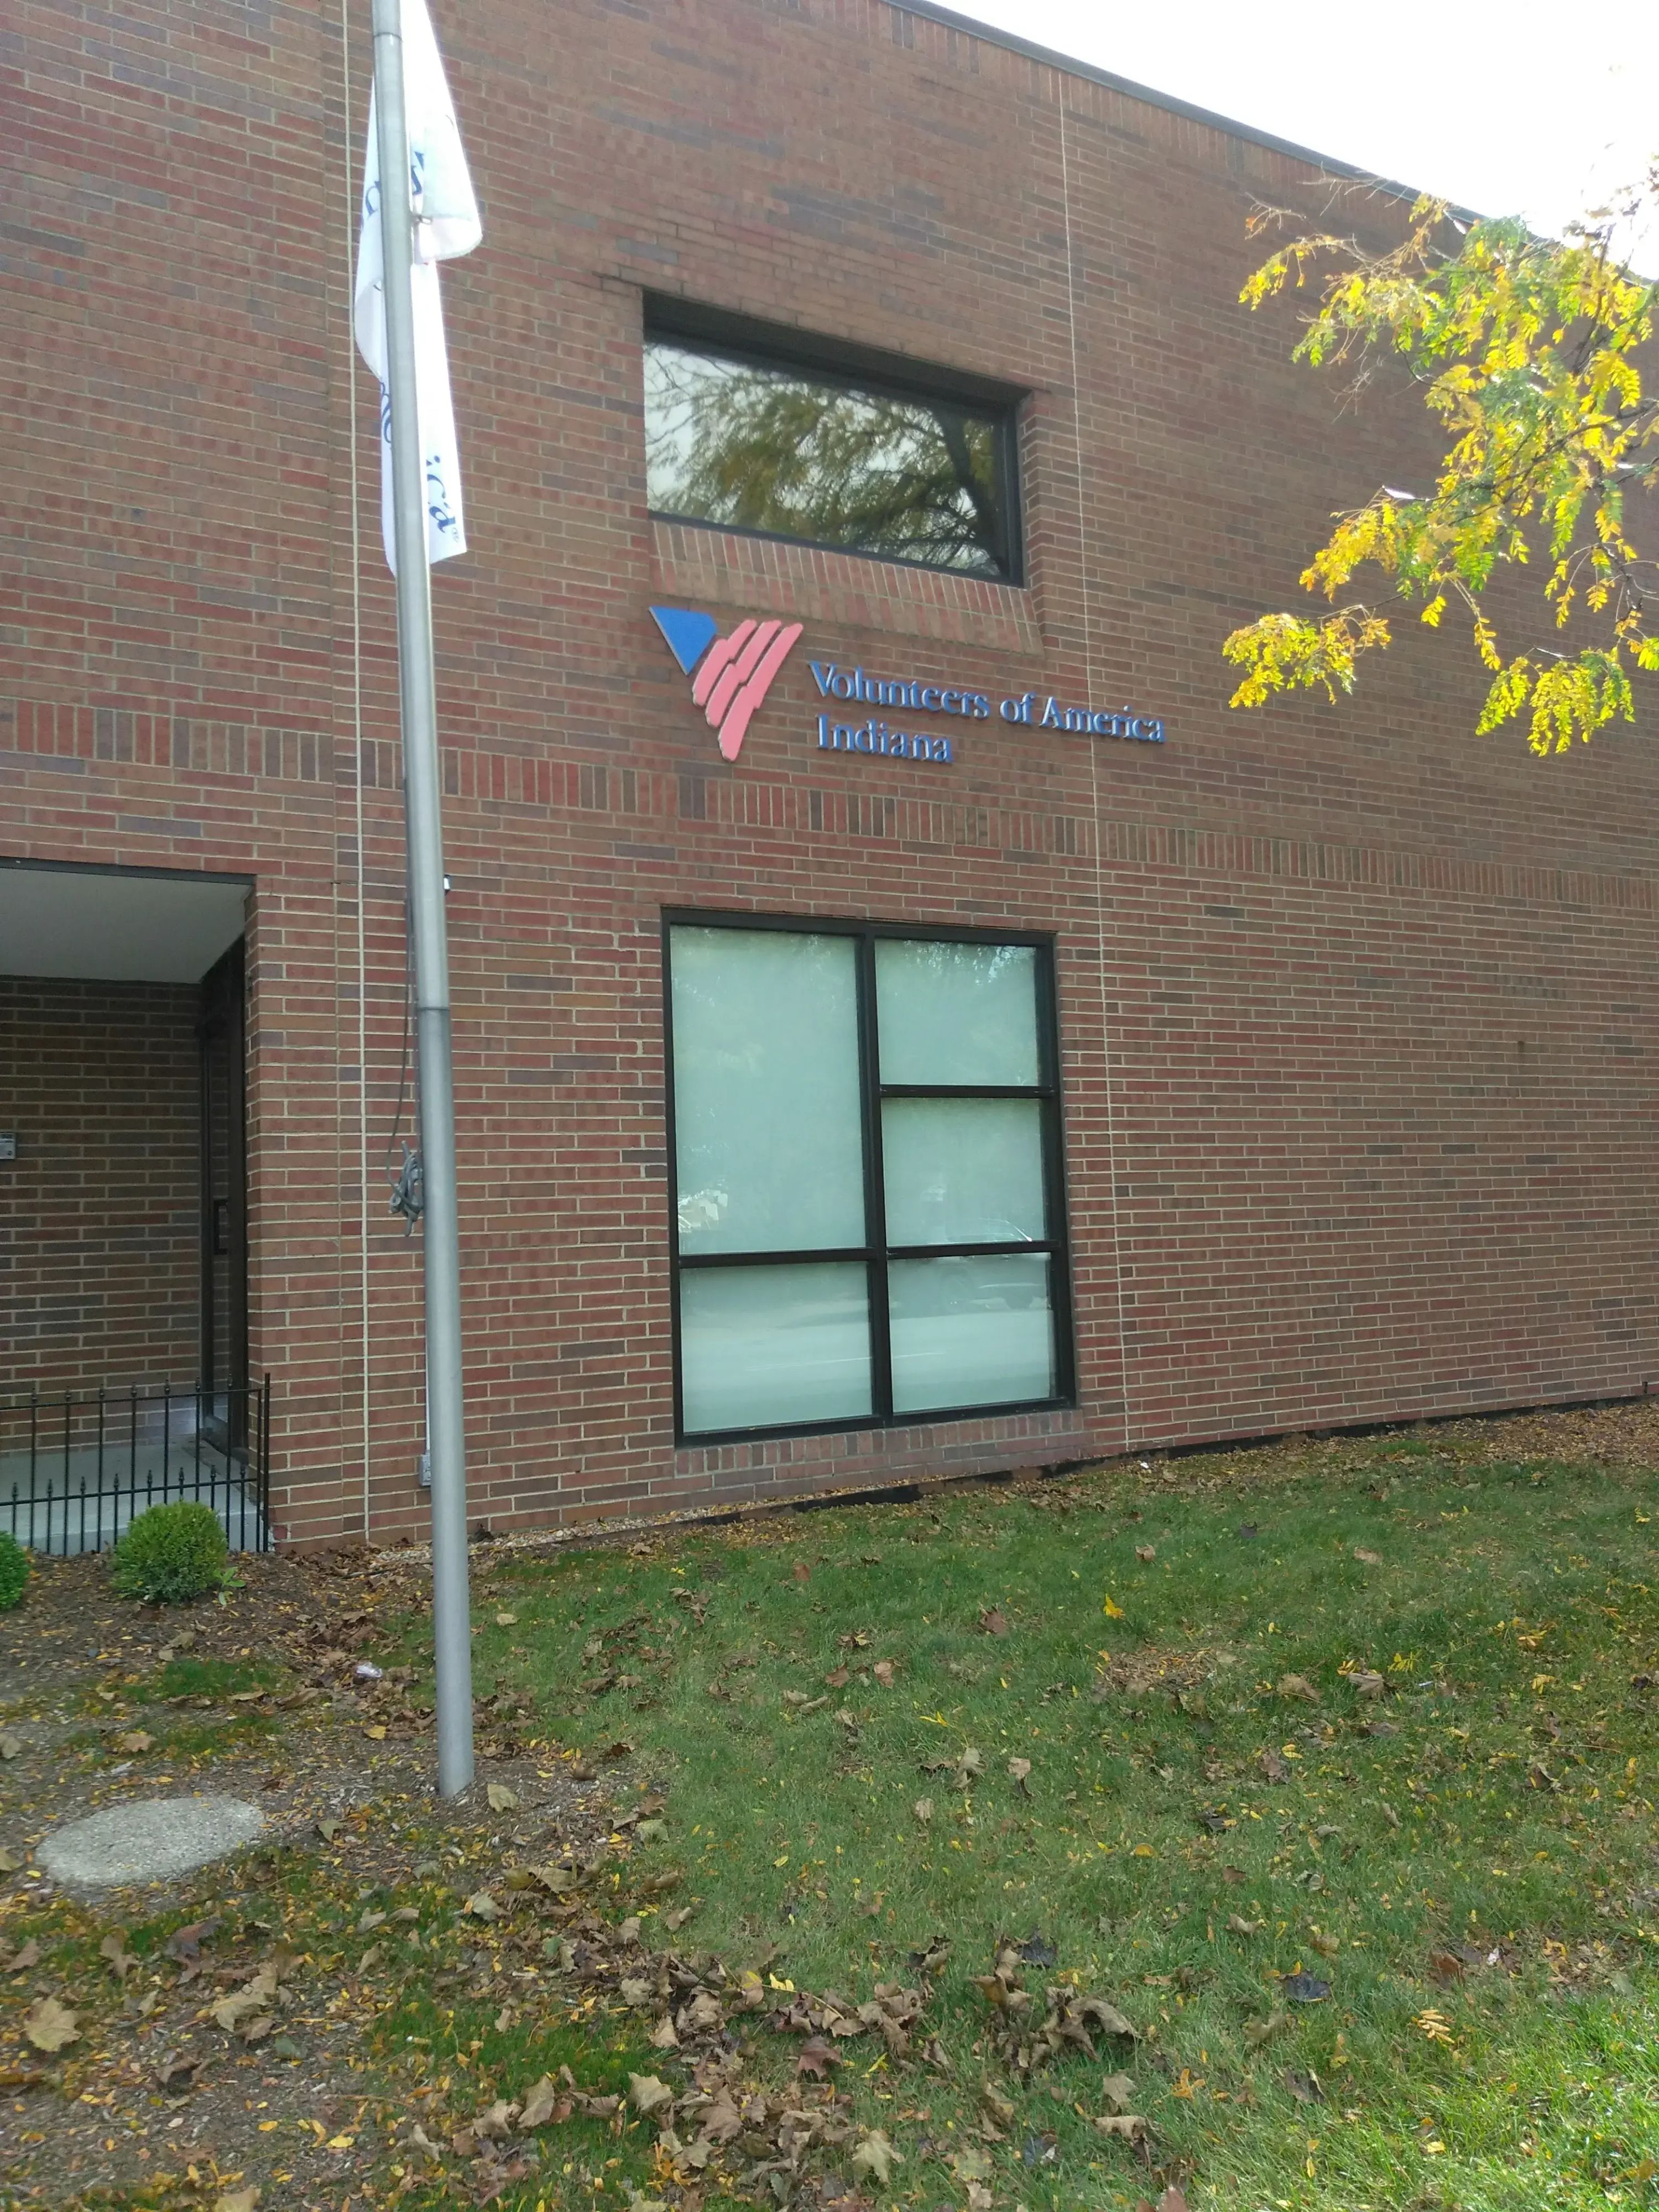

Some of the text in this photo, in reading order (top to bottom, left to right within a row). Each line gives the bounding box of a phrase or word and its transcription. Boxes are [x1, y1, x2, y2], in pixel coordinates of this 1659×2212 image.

[808, 661, 1164, 742] Volunteers of America
[816, 714, 952, 762] Indiana
